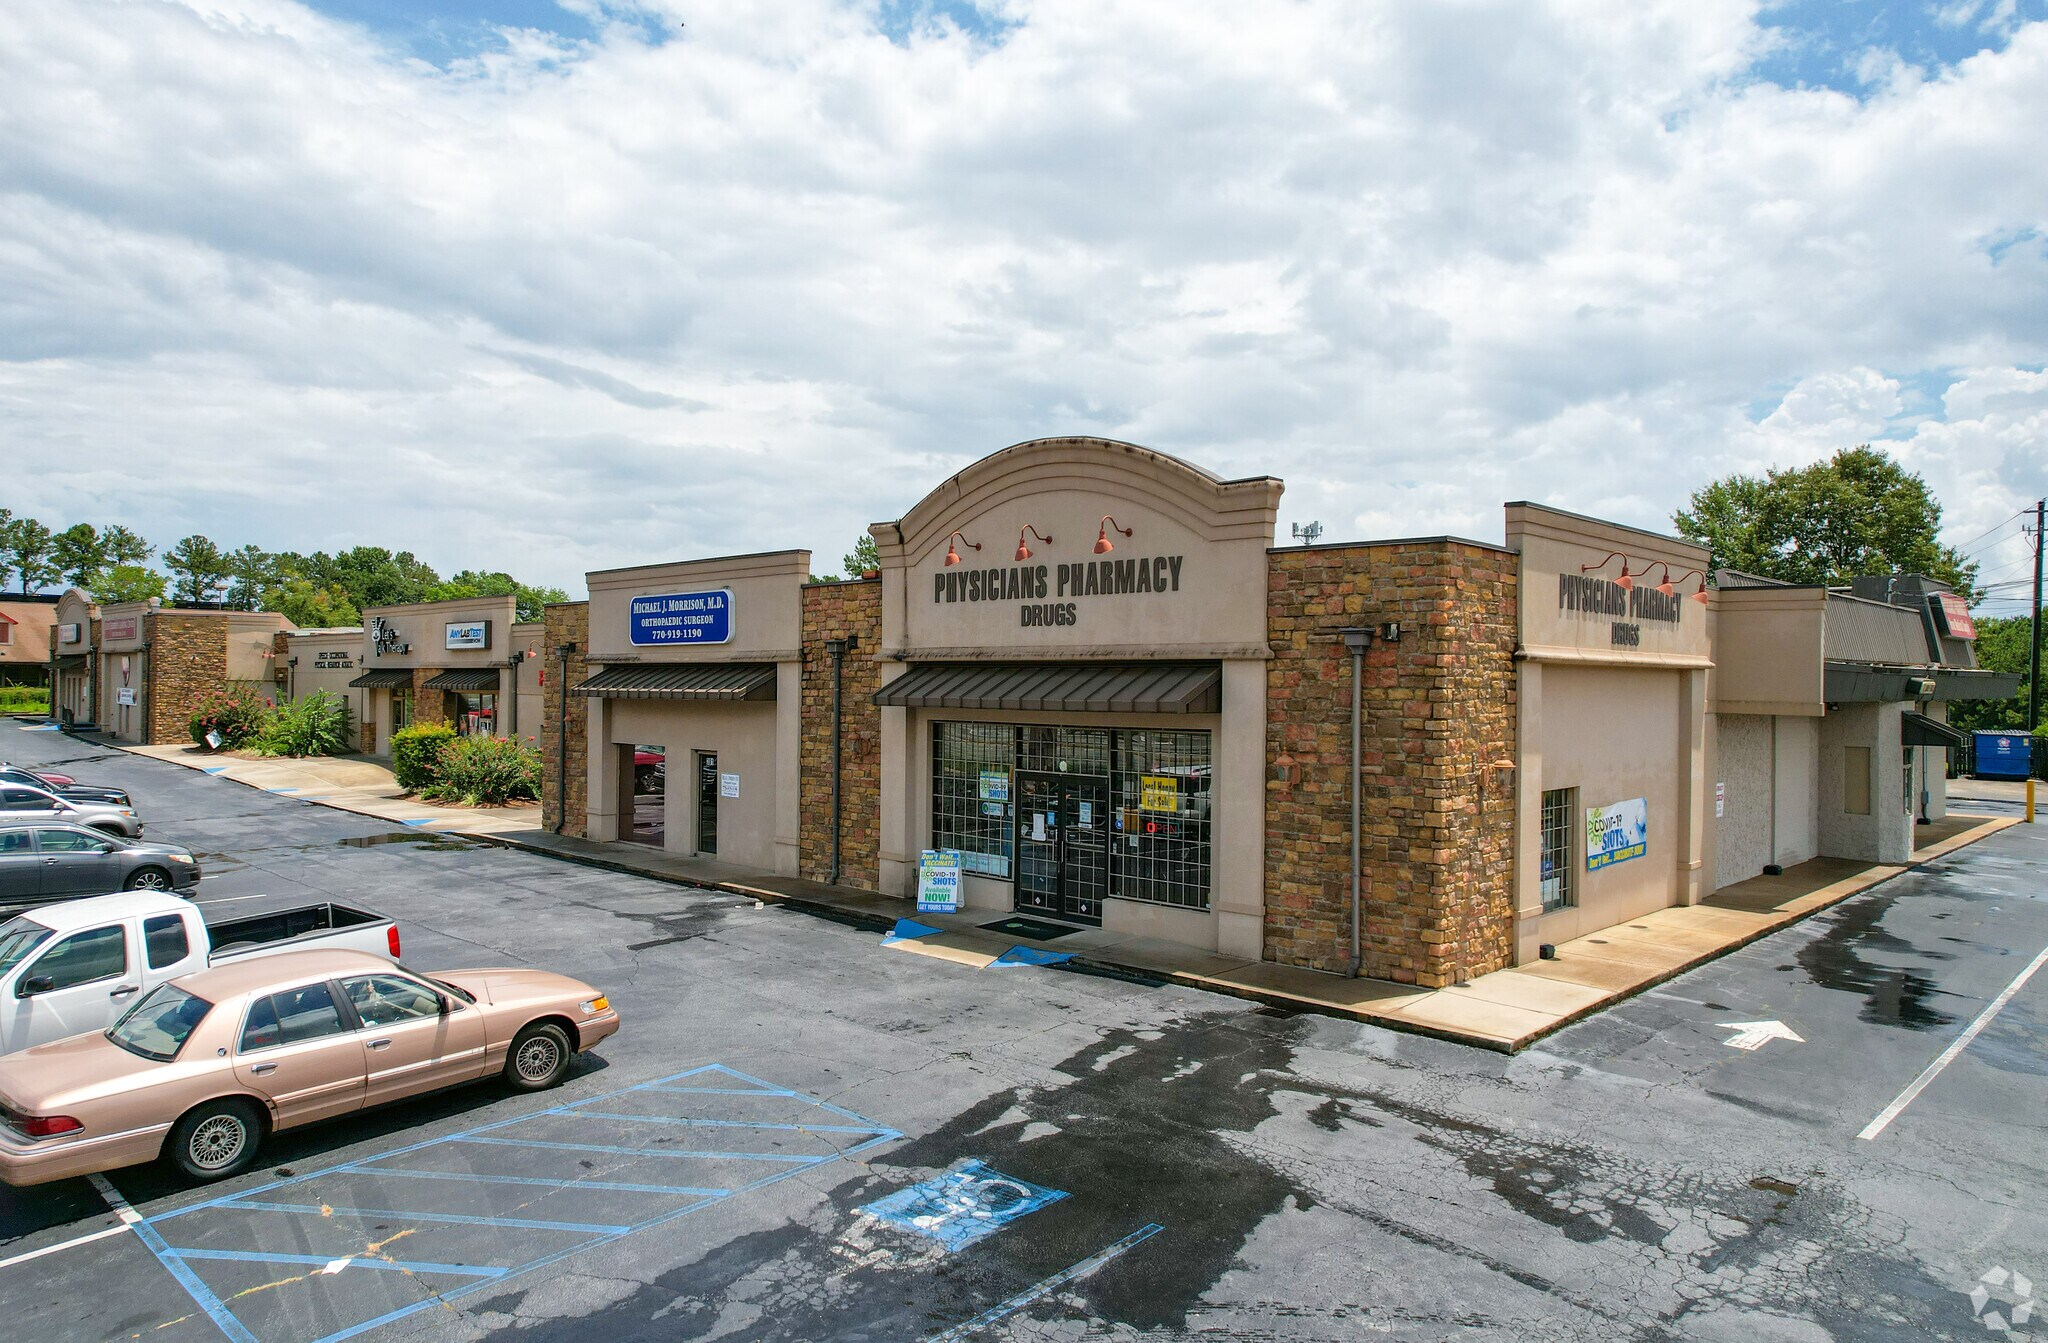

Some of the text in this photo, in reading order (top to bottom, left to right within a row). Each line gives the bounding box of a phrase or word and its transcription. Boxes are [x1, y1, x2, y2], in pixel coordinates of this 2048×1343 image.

[934, 556, 1183, 603] PHYSICIANS PHARMACY
[1559, 573, 1682, 623] PHYSICIANS PHARMACY
[633, 596, 724, 614] MICHAEL J. MORRISON, M.D.
[641, 615, 714, 627] ORTHOPAEDIC SURGEON
[1021, 603, 1077, 627] DRUGS
[652, 629, 702, 639] 770-919-1190
[1611, 622, 1640, 646] DRUGS
[385, 641, 406, 655] Therapy
[989, 789, 1007, 799] SHOTS
[1147, 822, 1177, 834] OPEN
[932, 878, 957, 886] SHOTS
[925, 893, 950, 902] NOW!
